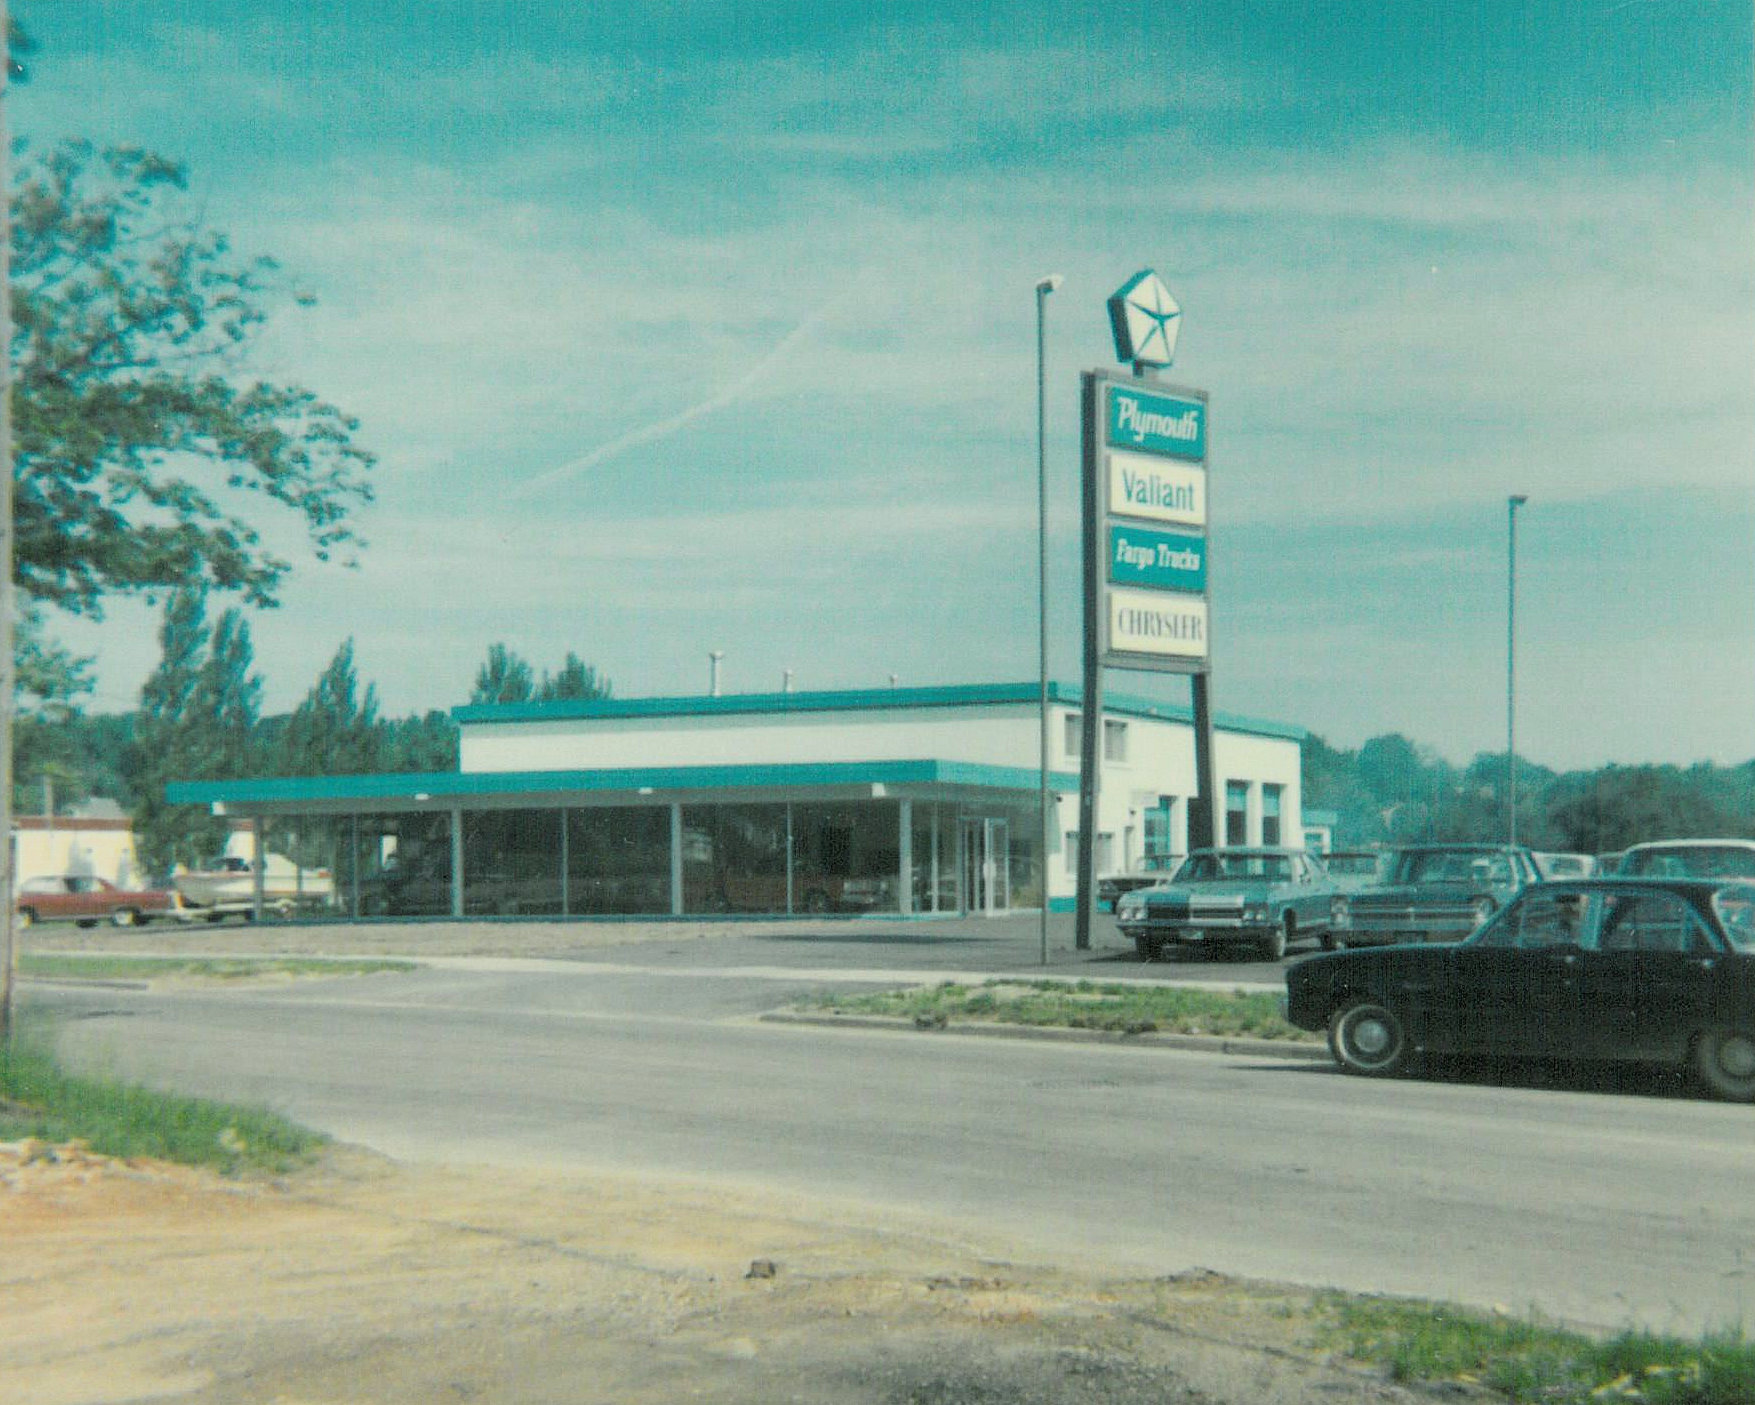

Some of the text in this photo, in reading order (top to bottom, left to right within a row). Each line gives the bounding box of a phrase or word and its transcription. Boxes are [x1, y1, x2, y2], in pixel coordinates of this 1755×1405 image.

[1117, 396, 1198, 442] Plymouth
[1122, 468, 1195, 512] Valiant
[1117, 538, 1200, 571] Fargo Trucks
[1119, 607, 1203, 641] CHRYSLER
